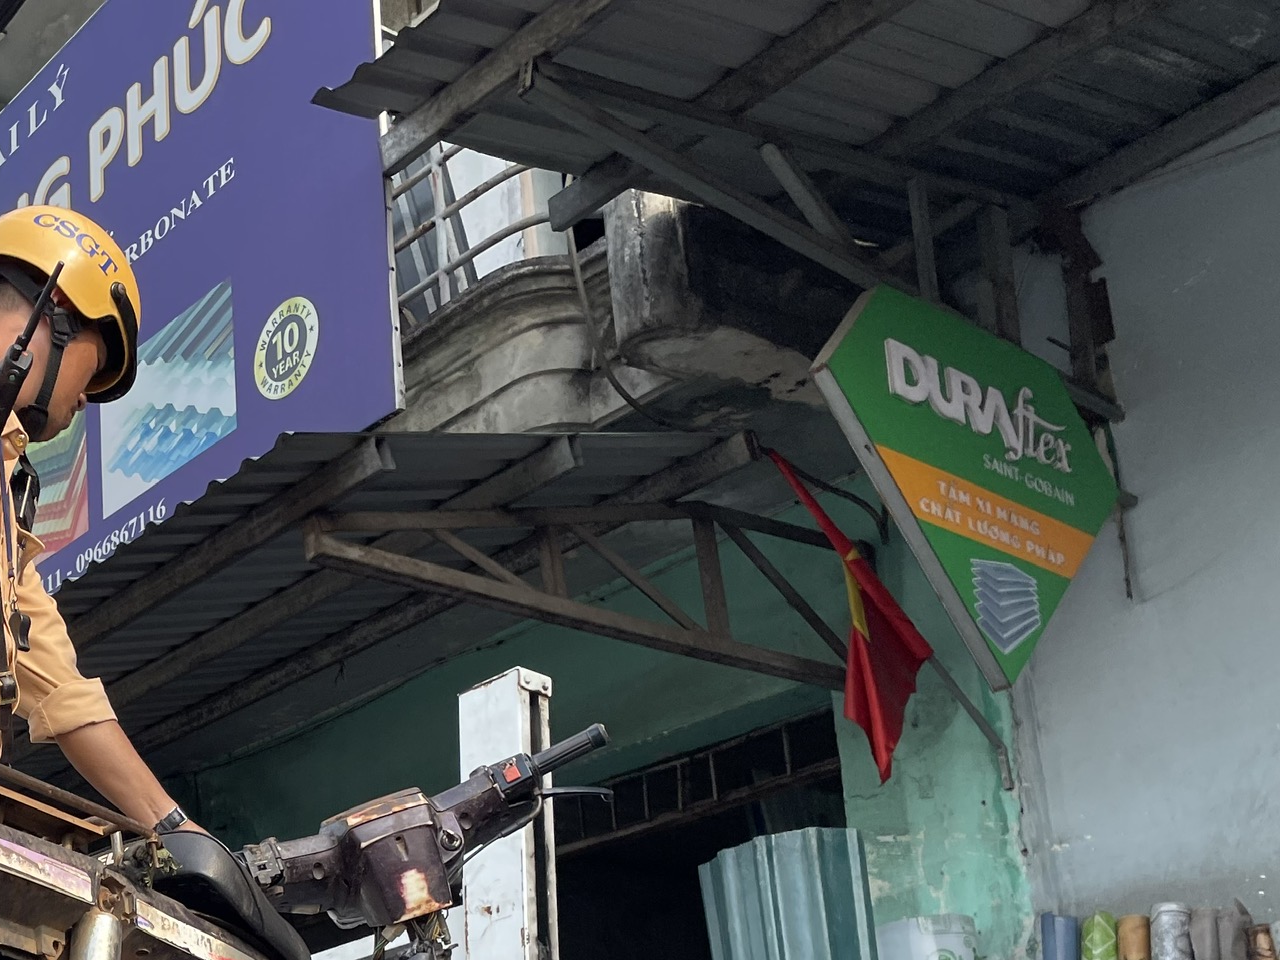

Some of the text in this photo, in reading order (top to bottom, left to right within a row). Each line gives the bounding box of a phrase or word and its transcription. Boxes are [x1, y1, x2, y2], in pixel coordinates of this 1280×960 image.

[27, 63, 70, 138] LÝ
[89, 0, 272, 204] PHÚC
[124, 157, 236, 266] RBONATE
[33, 213, 119, 276] CSGT
[260, 303, 312, 352] WARRANTY
[271, 321, 300, 361] 10
[260, 350, 312, 395] WARRANTY
[272, 351, 300, 379] YEAR
[982, 453, 1075, 507] SAINT-GOBAIN
[76, 497, 166, 573] 0966867116
